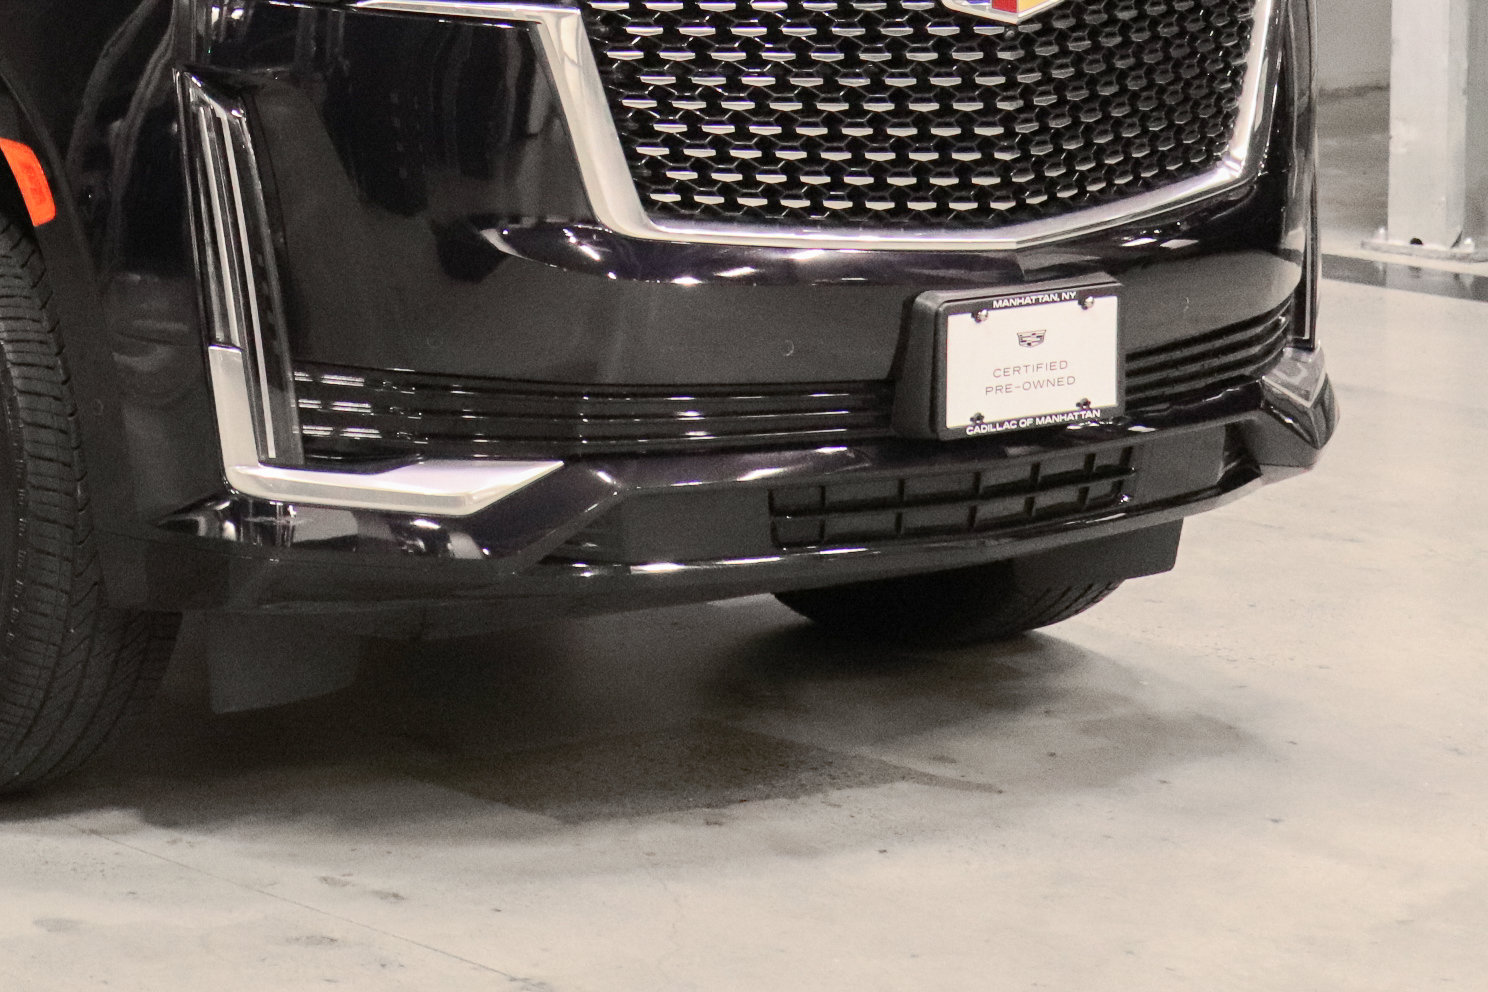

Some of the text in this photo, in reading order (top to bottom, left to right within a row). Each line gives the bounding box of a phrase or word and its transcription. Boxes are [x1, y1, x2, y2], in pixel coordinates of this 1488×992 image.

[1061, 291, 1077, 301] NY
[992, 360, 1068, 378] CERTIFIED
[985, 375, 1076, 396] PRE-OWNED
[966, 409, 1101, 436] CADILLAC OF MANHATTAN
